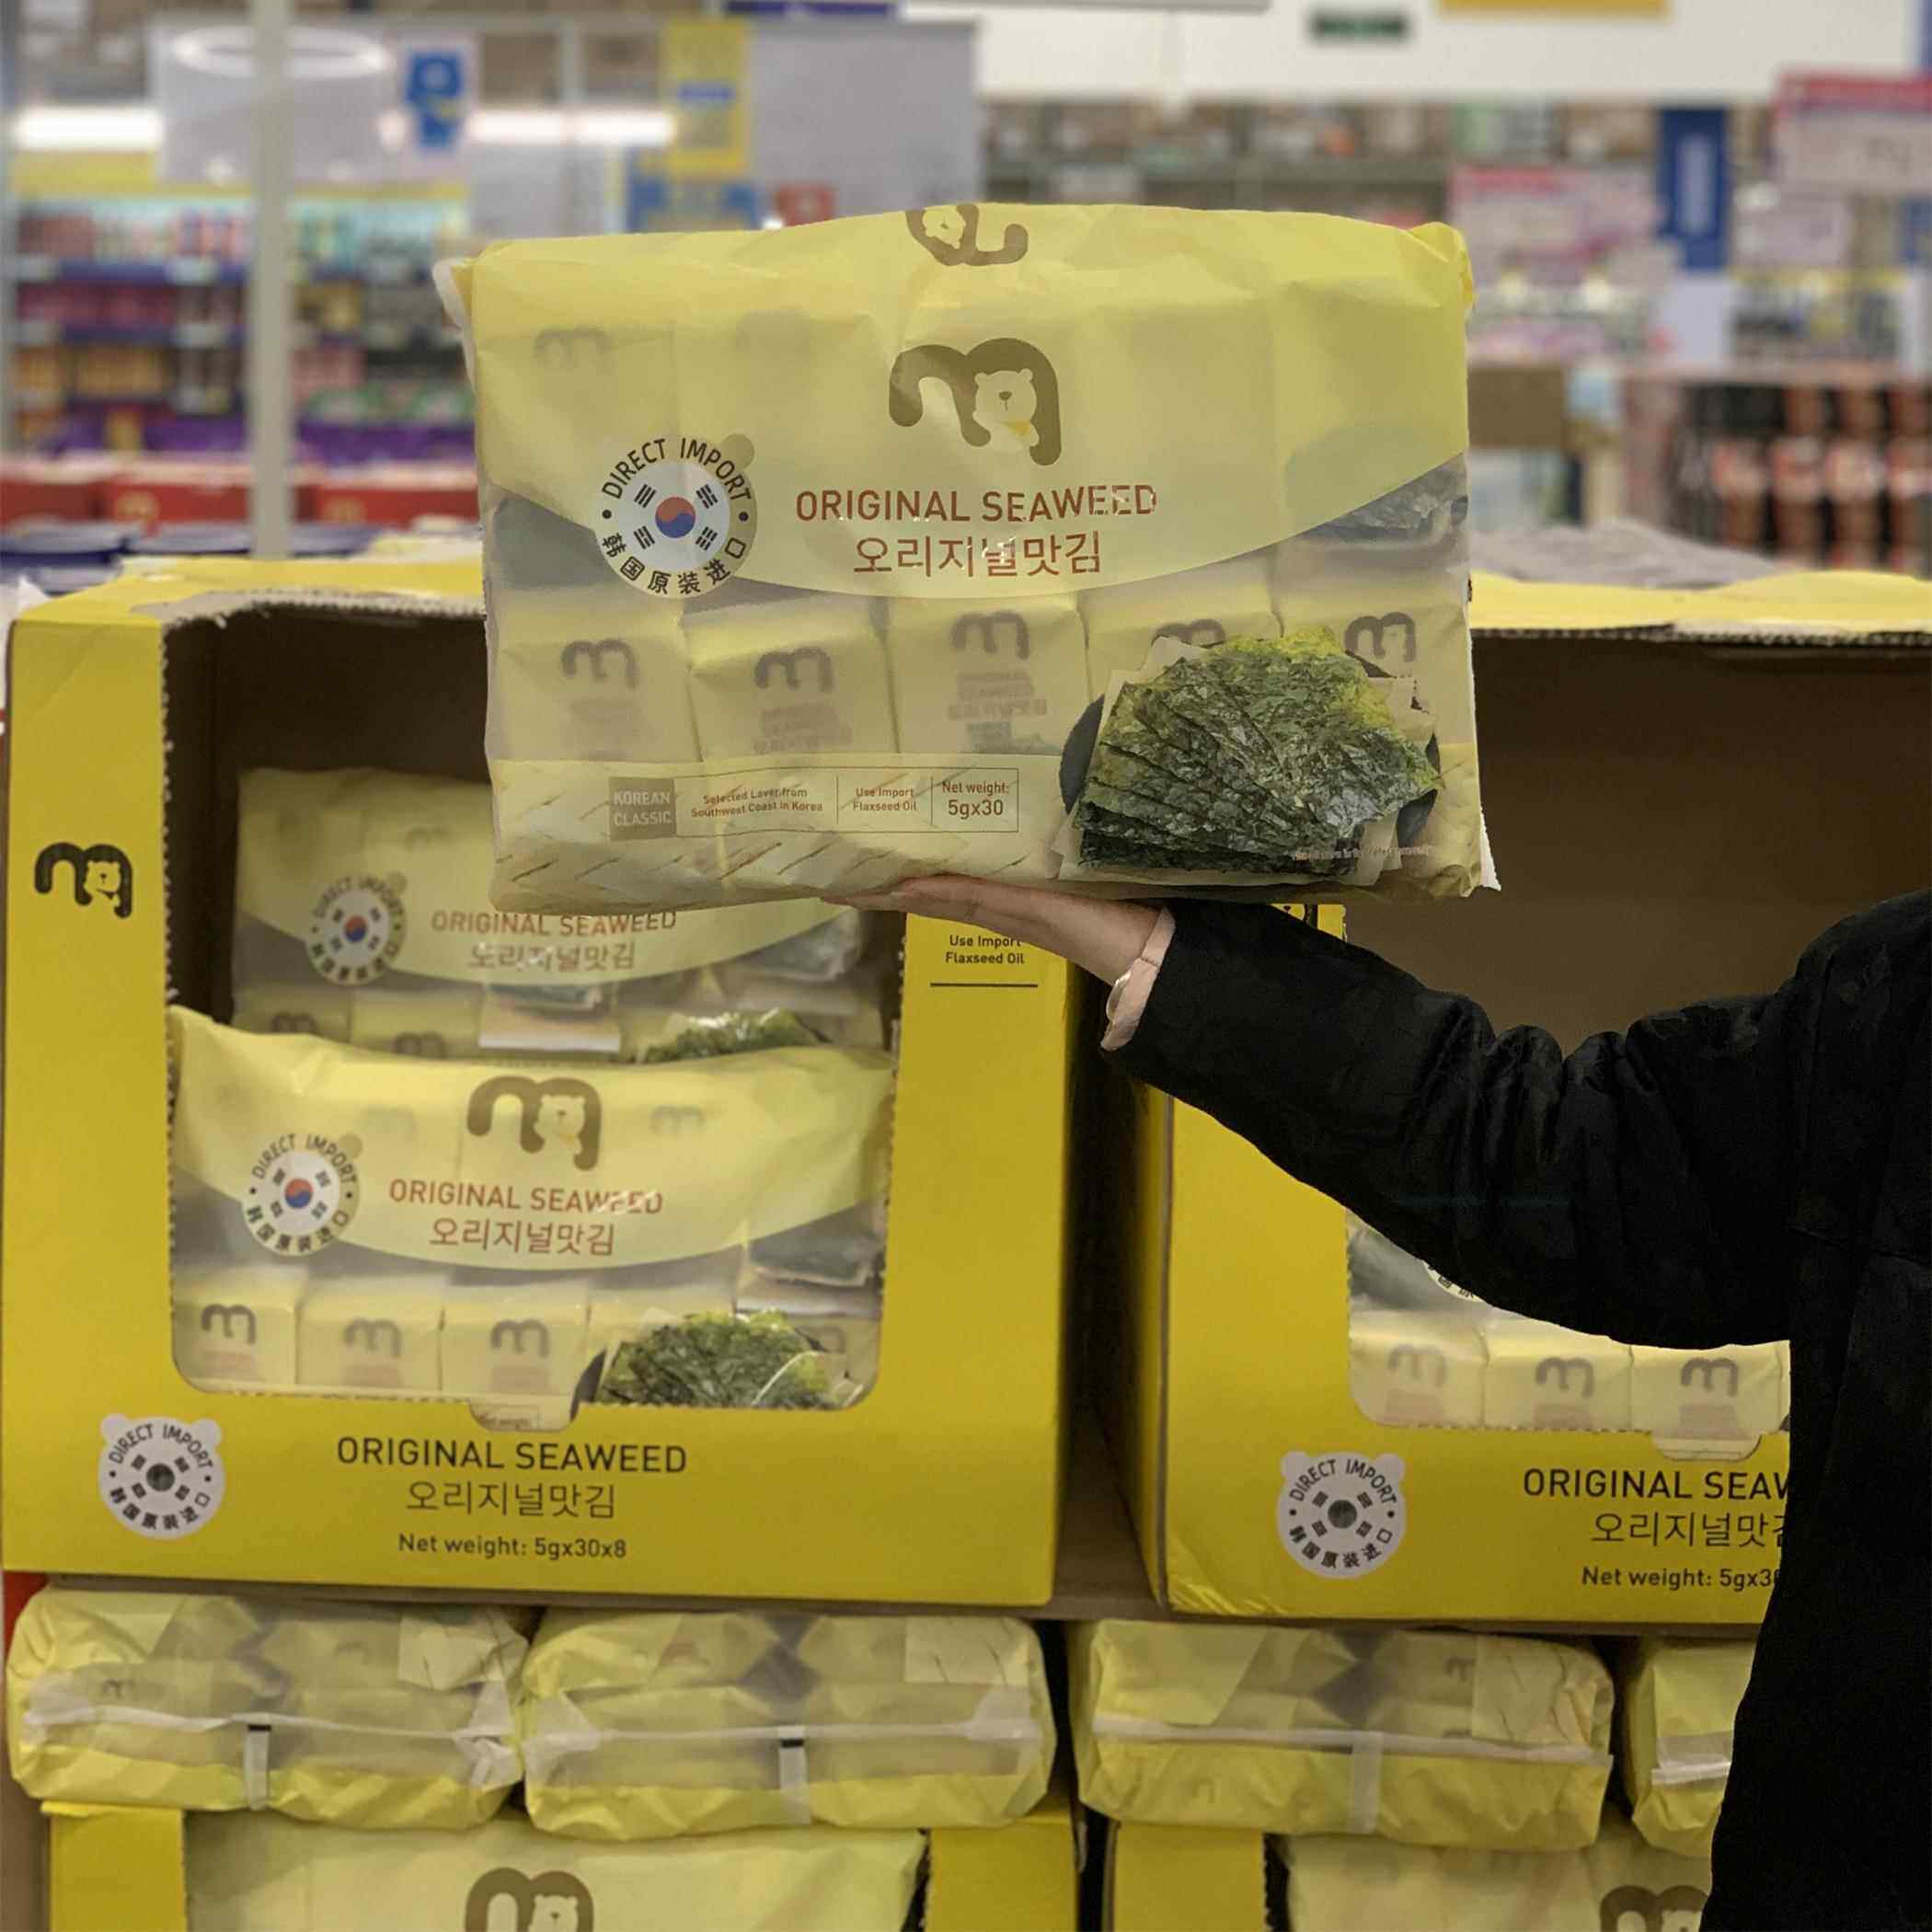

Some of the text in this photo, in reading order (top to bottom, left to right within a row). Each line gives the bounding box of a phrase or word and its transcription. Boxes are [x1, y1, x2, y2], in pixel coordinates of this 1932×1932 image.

[602, 437, 751, 500] DIRECT IMPORT
[796, 483, 1157, 523] ORIGINAL SEAWEED
[854, 530, 1101, 578] 오리지널맛김
[614, 790, 671, 807] KOREAN
[703, 792, 748, 806] Selected
[781, 787, 808, 799] from
[856, 787, 914, 799] Use Import
[942, 780, 1010, 797] Net weight:
[614, 810, 673, 827] CLASSIC
[691, 800, 823, 819] Southwest Coast in Korea
[853, 799, 916, 811] Flaxseed Oil
[948, 799, 1004, 820] 5gx30
[431, 910, 676, 936] ORIGINAL SEAWEED
[949, 935, 973, 946] Use
[946, 951, 1025, 964] Flaxseed Oil
[251, 1133, 356, 1182] DIRECT IMPORT
[389, 1179, 662, 1214] ORIGINAL SEAWEED
[429, 1218, 615, 1255] 오리지널맛김
[109, 1423, 213, 1467] DIRECT IMPORT
[337, 1436, 687, 1473] ORIGINAL SEAWEED
[1289, 1458, 1397, 1503] DIRECT IMPORT
[1524, 1468, 1693, 1498] ORIGINAL
[406, 1479, 616, 1520] 오리지널맛김
[398, 1533, 627, 1563] Net weight: 5gx30x8
[1582, 1567, 1622, 1585] Net
[1629, 1569, 1711, 1590] weight:
